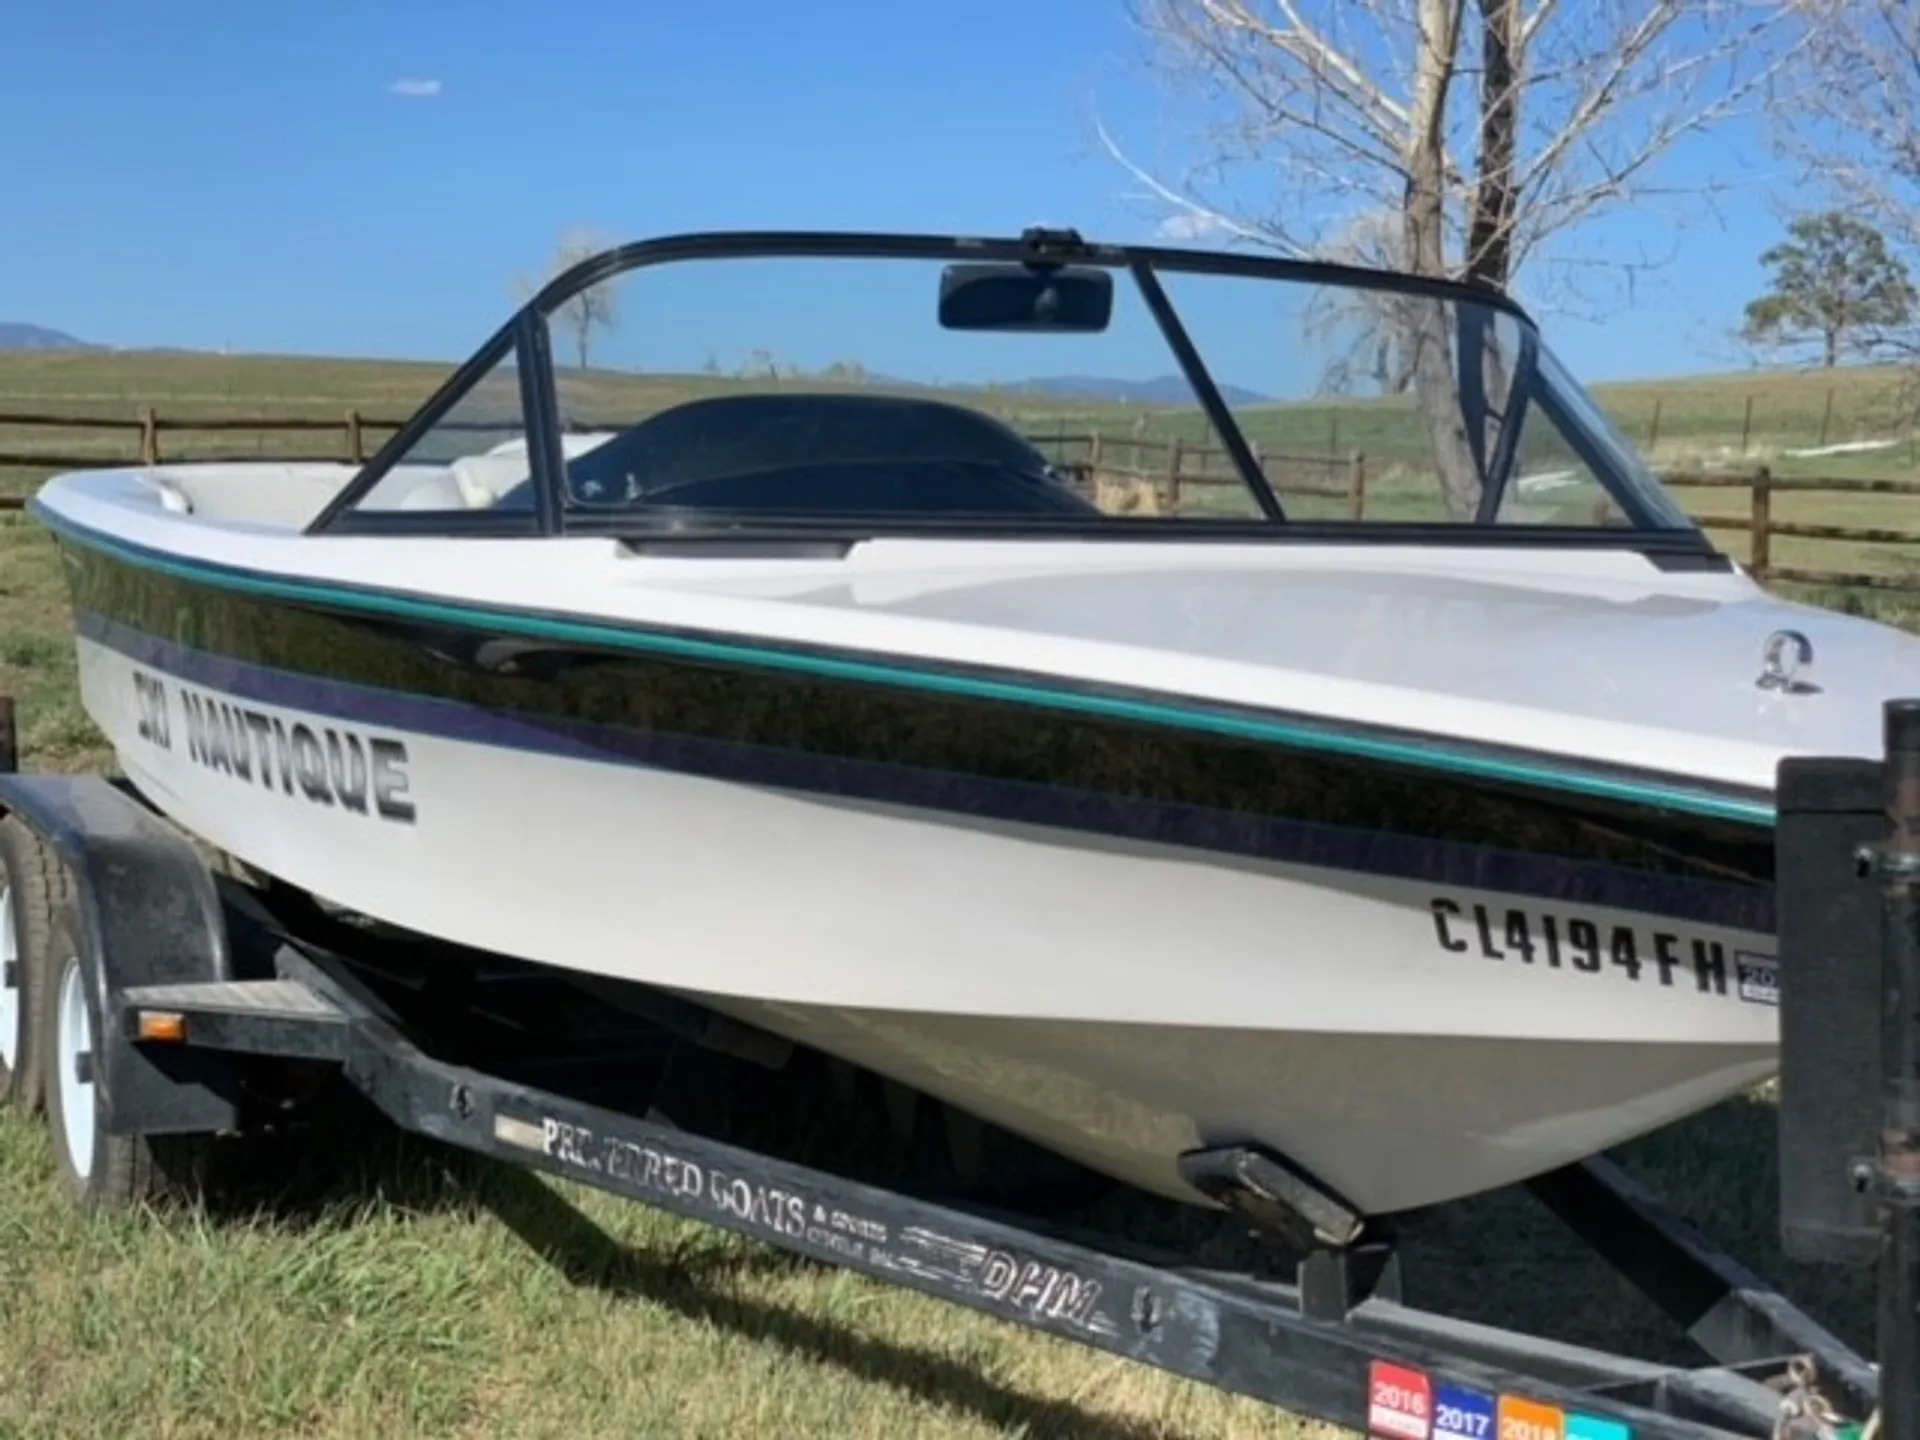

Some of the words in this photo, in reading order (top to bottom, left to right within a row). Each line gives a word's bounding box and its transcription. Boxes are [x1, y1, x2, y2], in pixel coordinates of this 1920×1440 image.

[180, 688, 416, 825] NAUTIQUE
[1373, 1382, 1426, 1415] 2016
[1435, 1403, 1491, 1437] 2017
